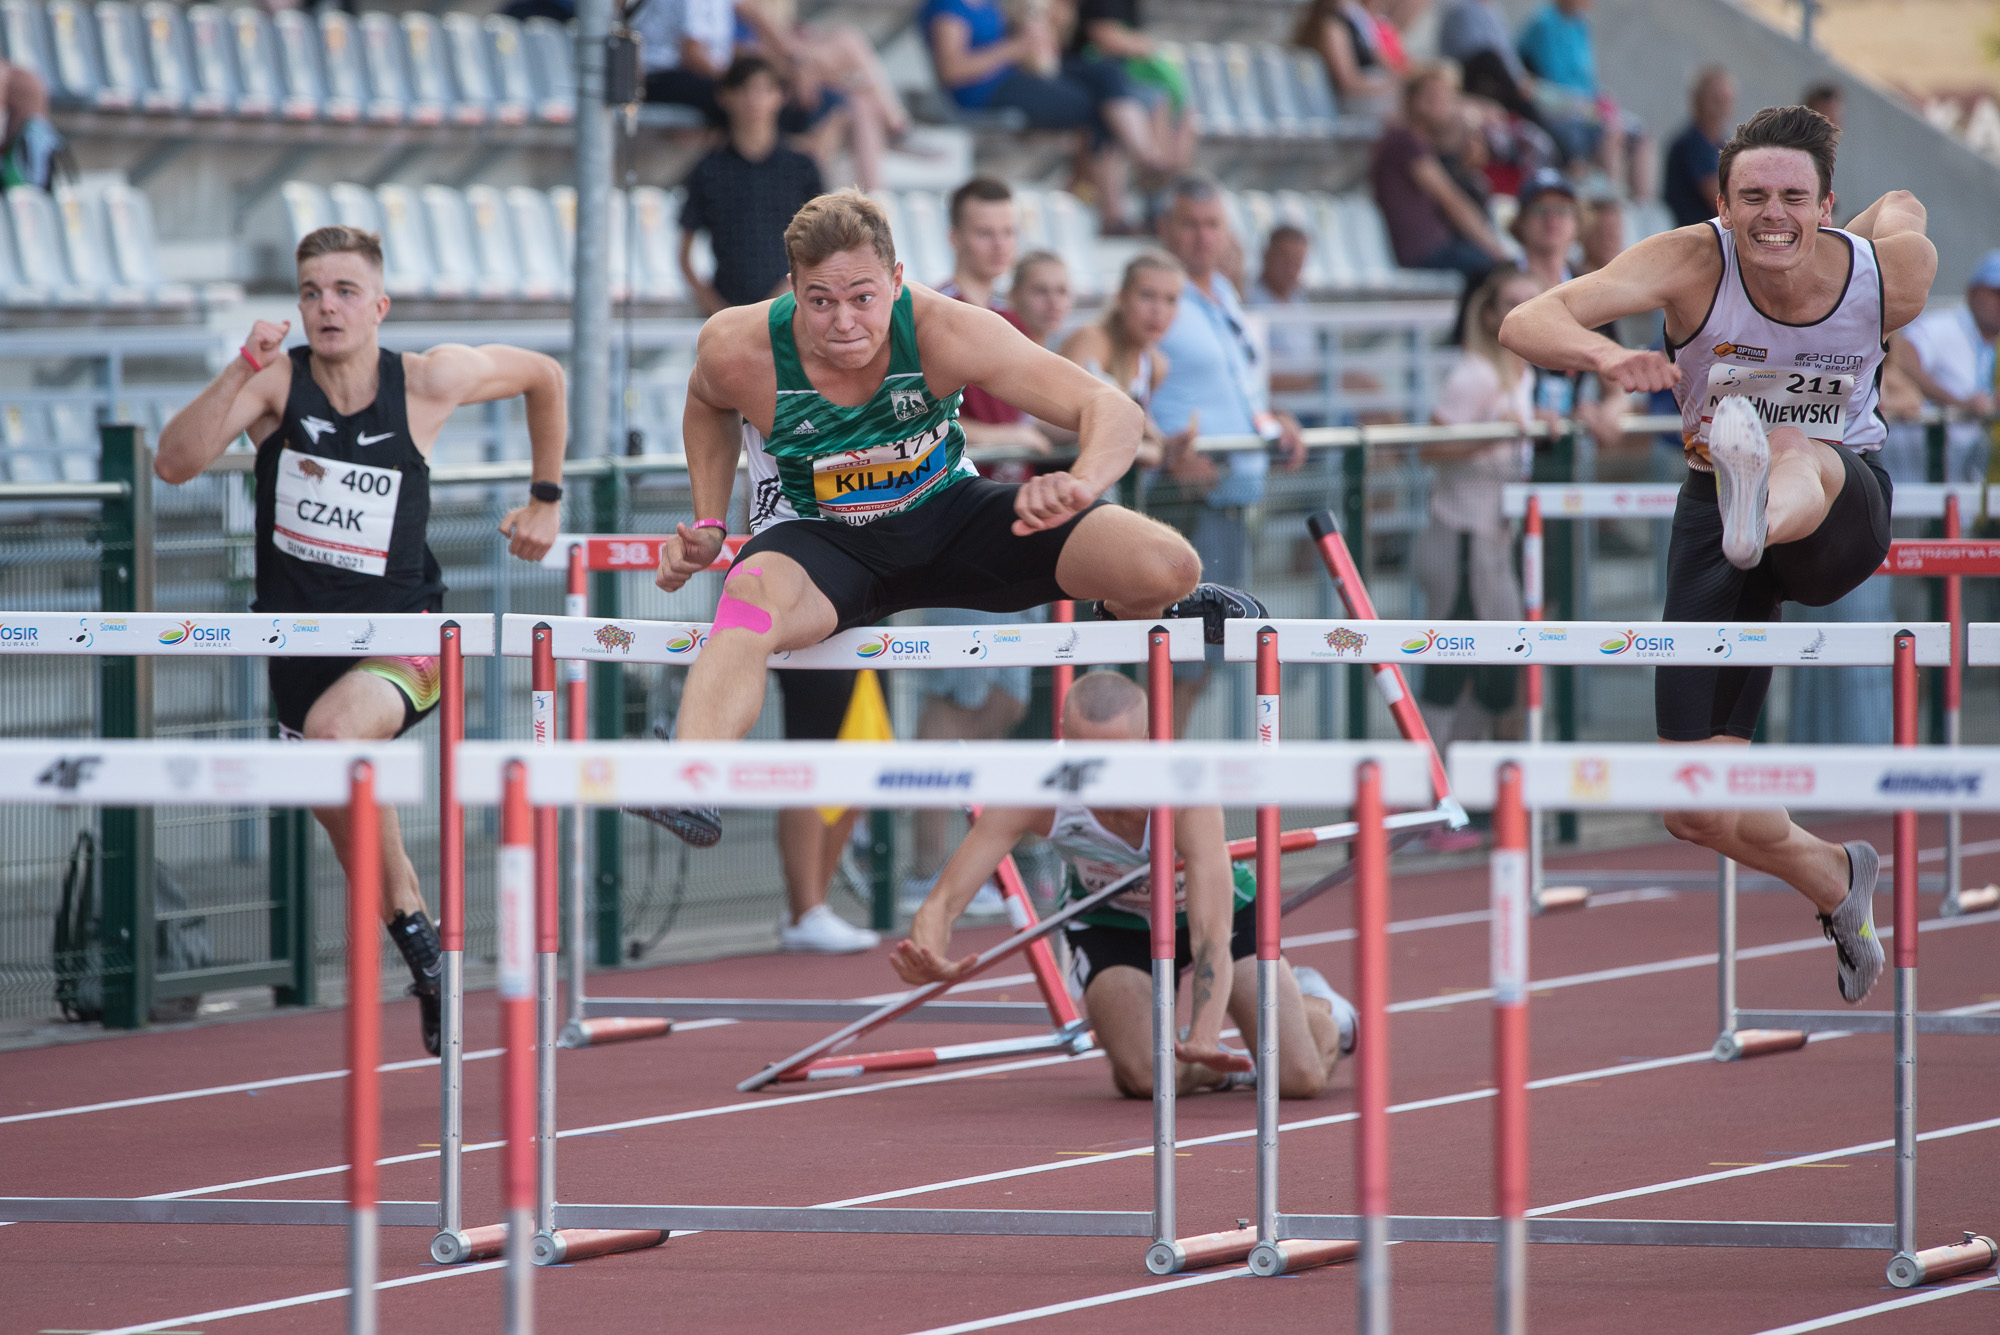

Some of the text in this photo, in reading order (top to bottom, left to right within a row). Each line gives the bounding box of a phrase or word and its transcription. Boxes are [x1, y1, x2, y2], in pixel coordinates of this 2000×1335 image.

[1736, 346, 1766, 358] OPTIMA
[1814, 361, 1822, 369] w
[1785, 373, 1843, 395] 211
[1709, 394, 1840, 425] MHNIEWSKI
[893, 427, 942, 460] 171
[829, 460, 868, 470] ORLEN
[835, 456, 931, 493] KILJAN
[341, 470, 391, 496] 400
[297, 499, 364, 532] CZAK
[0, 627, 39, 640] OSIR
[193, 627, 231, 641] OSIR
[891, 640, 930, 654] OSIR
[1436, 637, 1475, 650] OSIR
[1635, 637, 1675, 651] OSIR
